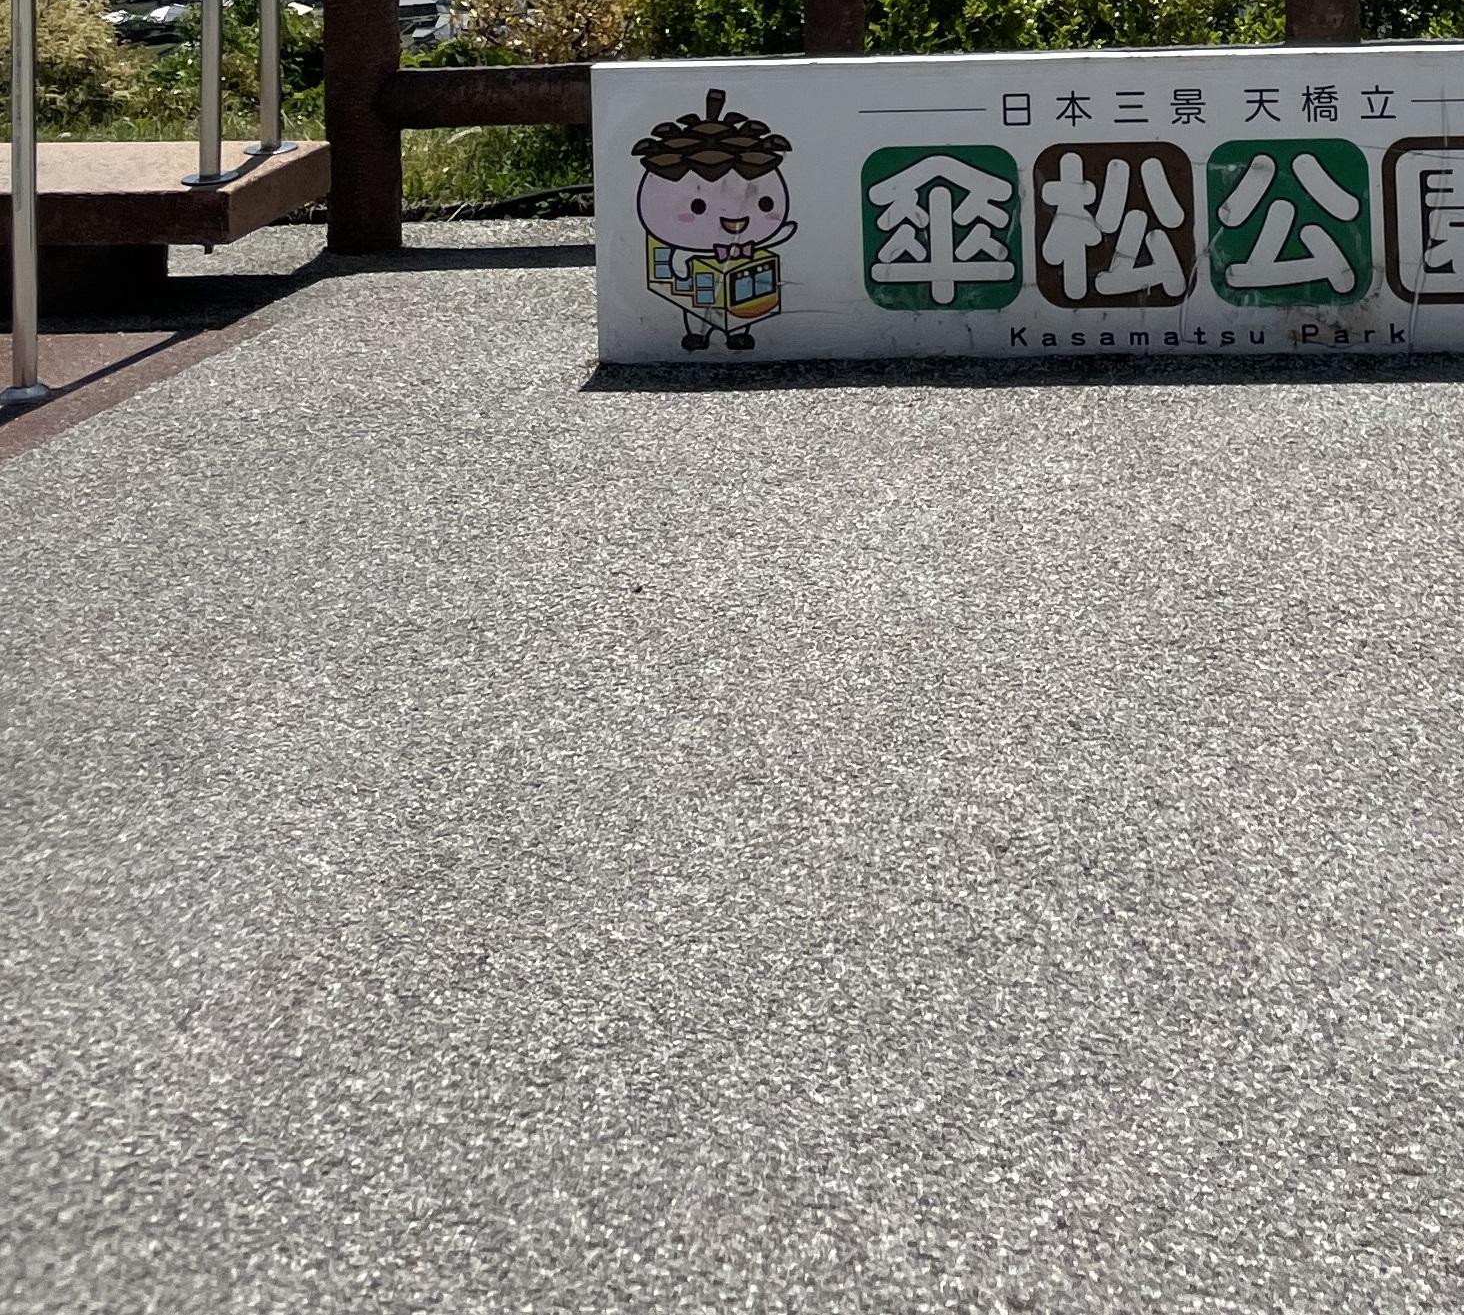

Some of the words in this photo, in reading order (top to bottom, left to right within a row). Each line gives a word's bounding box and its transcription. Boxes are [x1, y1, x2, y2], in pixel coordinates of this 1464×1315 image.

[1002, 88, 1206, 127] 日本三景
[1243, 84, 1397, 123] 天橋立
[1010, 326, 1265, 347] Kasamatsu
[1301, 323, 1406, 343] Park
